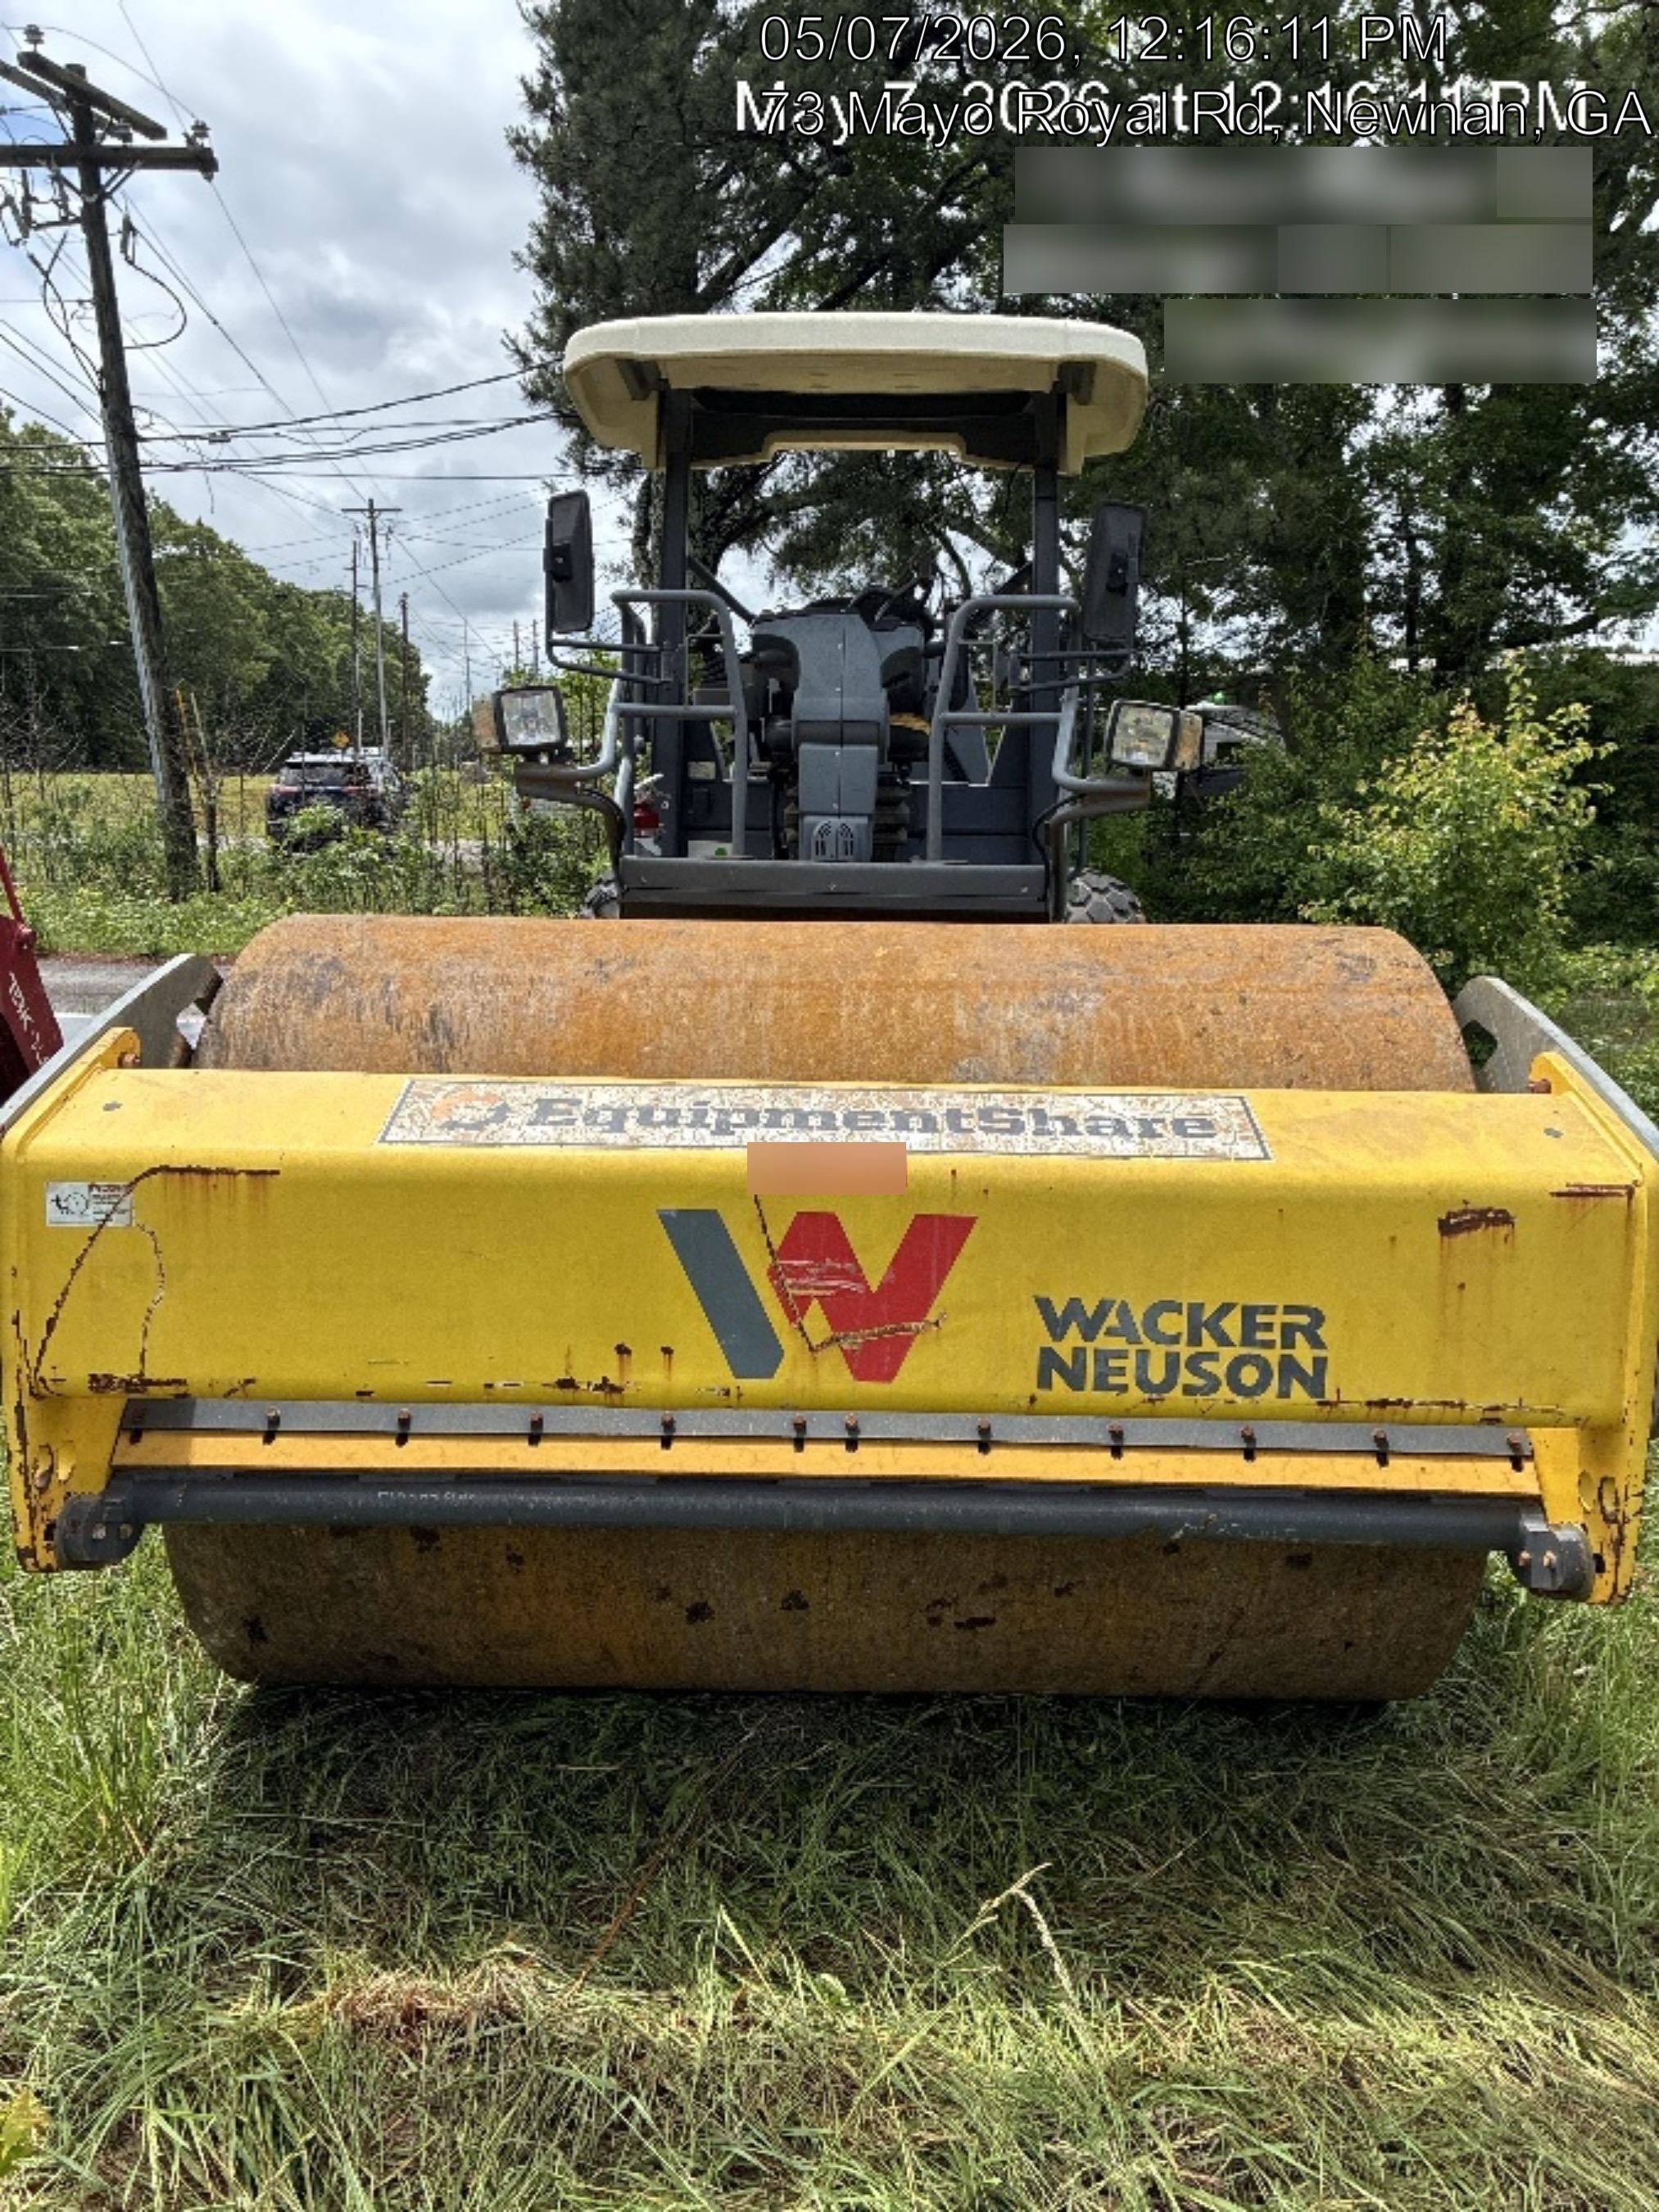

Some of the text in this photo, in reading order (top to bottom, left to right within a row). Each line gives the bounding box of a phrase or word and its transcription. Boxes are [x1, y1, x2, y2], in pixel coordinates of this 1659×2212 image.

[525, 1097, 1218, 1140] EquipmentShare
[1032, 1294, 1328, 1350] WACKER
[1036, 1346, 1328, 1399] NEUSON
